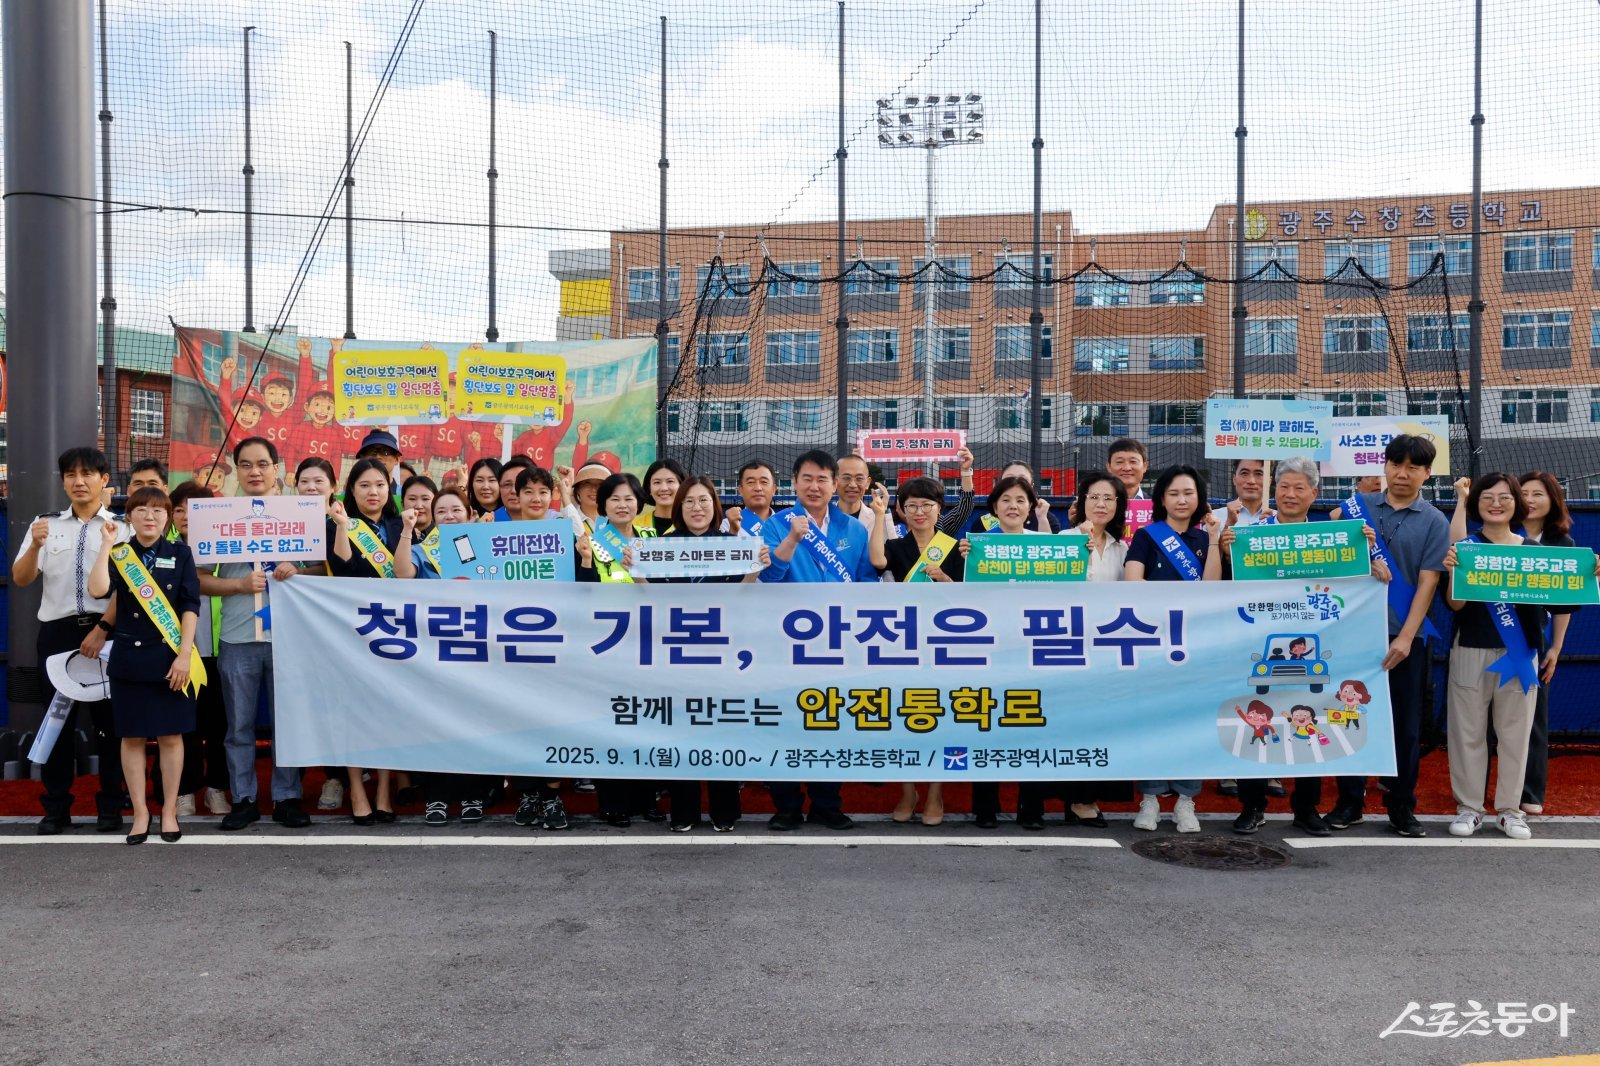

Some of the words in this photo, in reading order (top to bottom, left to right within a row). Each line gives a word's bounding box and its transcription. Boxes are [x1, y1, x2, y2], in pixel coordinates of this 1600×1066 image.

[1279, 200, 1543, 236] 광주수창초등학교
[345, 366, 438, 378] 어린이보호구역에선
[468, 366, 555, 381] 어린이보호구역에선
[342, 381, 384, 397] 횡단보도
[386, 382, 398, 396] 앞
[400, 381, 442, 396] 일단멈춤
[464, 379, 502, 395] 횡단보도
[505, 382, 516, 395] 앞
[518, 382, 557, 399] 일단멈춤
[267, 427, 287, 441] SC
[344, 426, 360, 440] SC
[437, 427, 456, 443] SC
[1279, 420, 1319, 435] 말해도,
[309, 440, 328, 454] SC
[400, 434, 417, 448] SC
[871, 439, 892, 449] 불법
[933, 439, 954, 449] 금지
[1215, 434, 1248, 447] 청탁이
[1251, 436, 1262, 448] 될
[1265, 437, 1276, 447] 수
[1279, 437, 1323, 448] 있습니다.
[1339, 434, 1377, 447] 사소한
[251, 521, 306, 536] 돌리길래
[198, 541, 212, 555] 안
[215, 540, 243, 555] 돌릴
[246, 540, 273, 554] 수도
[491, 533, 565, 557] 휴대전화,
[1249, 535, 1290, 551] 청렴한
[1293, 531, 1349, 549] 광주교육
[639, 550, 675, 562] 보행중
[679, 550, 726, 561] 스마트폰
[730, 550, 753, 561] 금지
[984, 544, 1024, 560] 청렴한
[1026, 545, 1079, 560] 광주교육
[1243, 552, 1279, 567] 실천이
[1282, 550, 1298, 566] 답!
[1301, 548, 1337, 565] 행동이
[1340, 547, 1356, 562] 힘!
[504, 559, 556, 581] 이어폰
[977, 560, 1012, 575] 실천이
[1015, 560, 1030, 575] 답!
[1033, 560, 1068, 575] 행동이
[1070, 561, 1084, 575] 힘!
[1474, 555, 1517, 571] 청렴한
[1521, 557, 1578, 574] 광주교육
[1466, 571, 1503, 587] 실천이
[1506, 573, 1523, 588] 답!
[1526, 573, 1564, 590] 행동이
[1567, 575, 1584, 590] 힘!
[1248, 602, 1257, 612] 단
[1282, 601, 1307, 611] 아이도
[1307, 593, 1332, 610] 광주
[1271, 612, 1300, 621] 포기하지
[1300, 611, 1315, 620] 않는
[1320, 603, 1341, 621] 교육
[355, 602, 564, 664] 청렴은
[591, 605, 753, 671] 기본,
[782, 605, 995, 665] 안전은
[1023, 605, 1186, 666] 필수!
[610, 695, 673, 726] 함께
[685, 696, 783, 726] 만드는
[796, 687, 1047, 734] 안전통학로
[545, 746, 600, 765] 2025.
[607, 748, 624, 765] 9.
[633, 746, 681, 768] 1.(월)
[688, 749, 763, 767] 08:00~
[769, 749, 779, 767] /
[784, 748, 922, 769] 광주수창초등학교
[927, 750, 937, 768] /
[971, 747, 1109, 768] 광주광역시교육청
